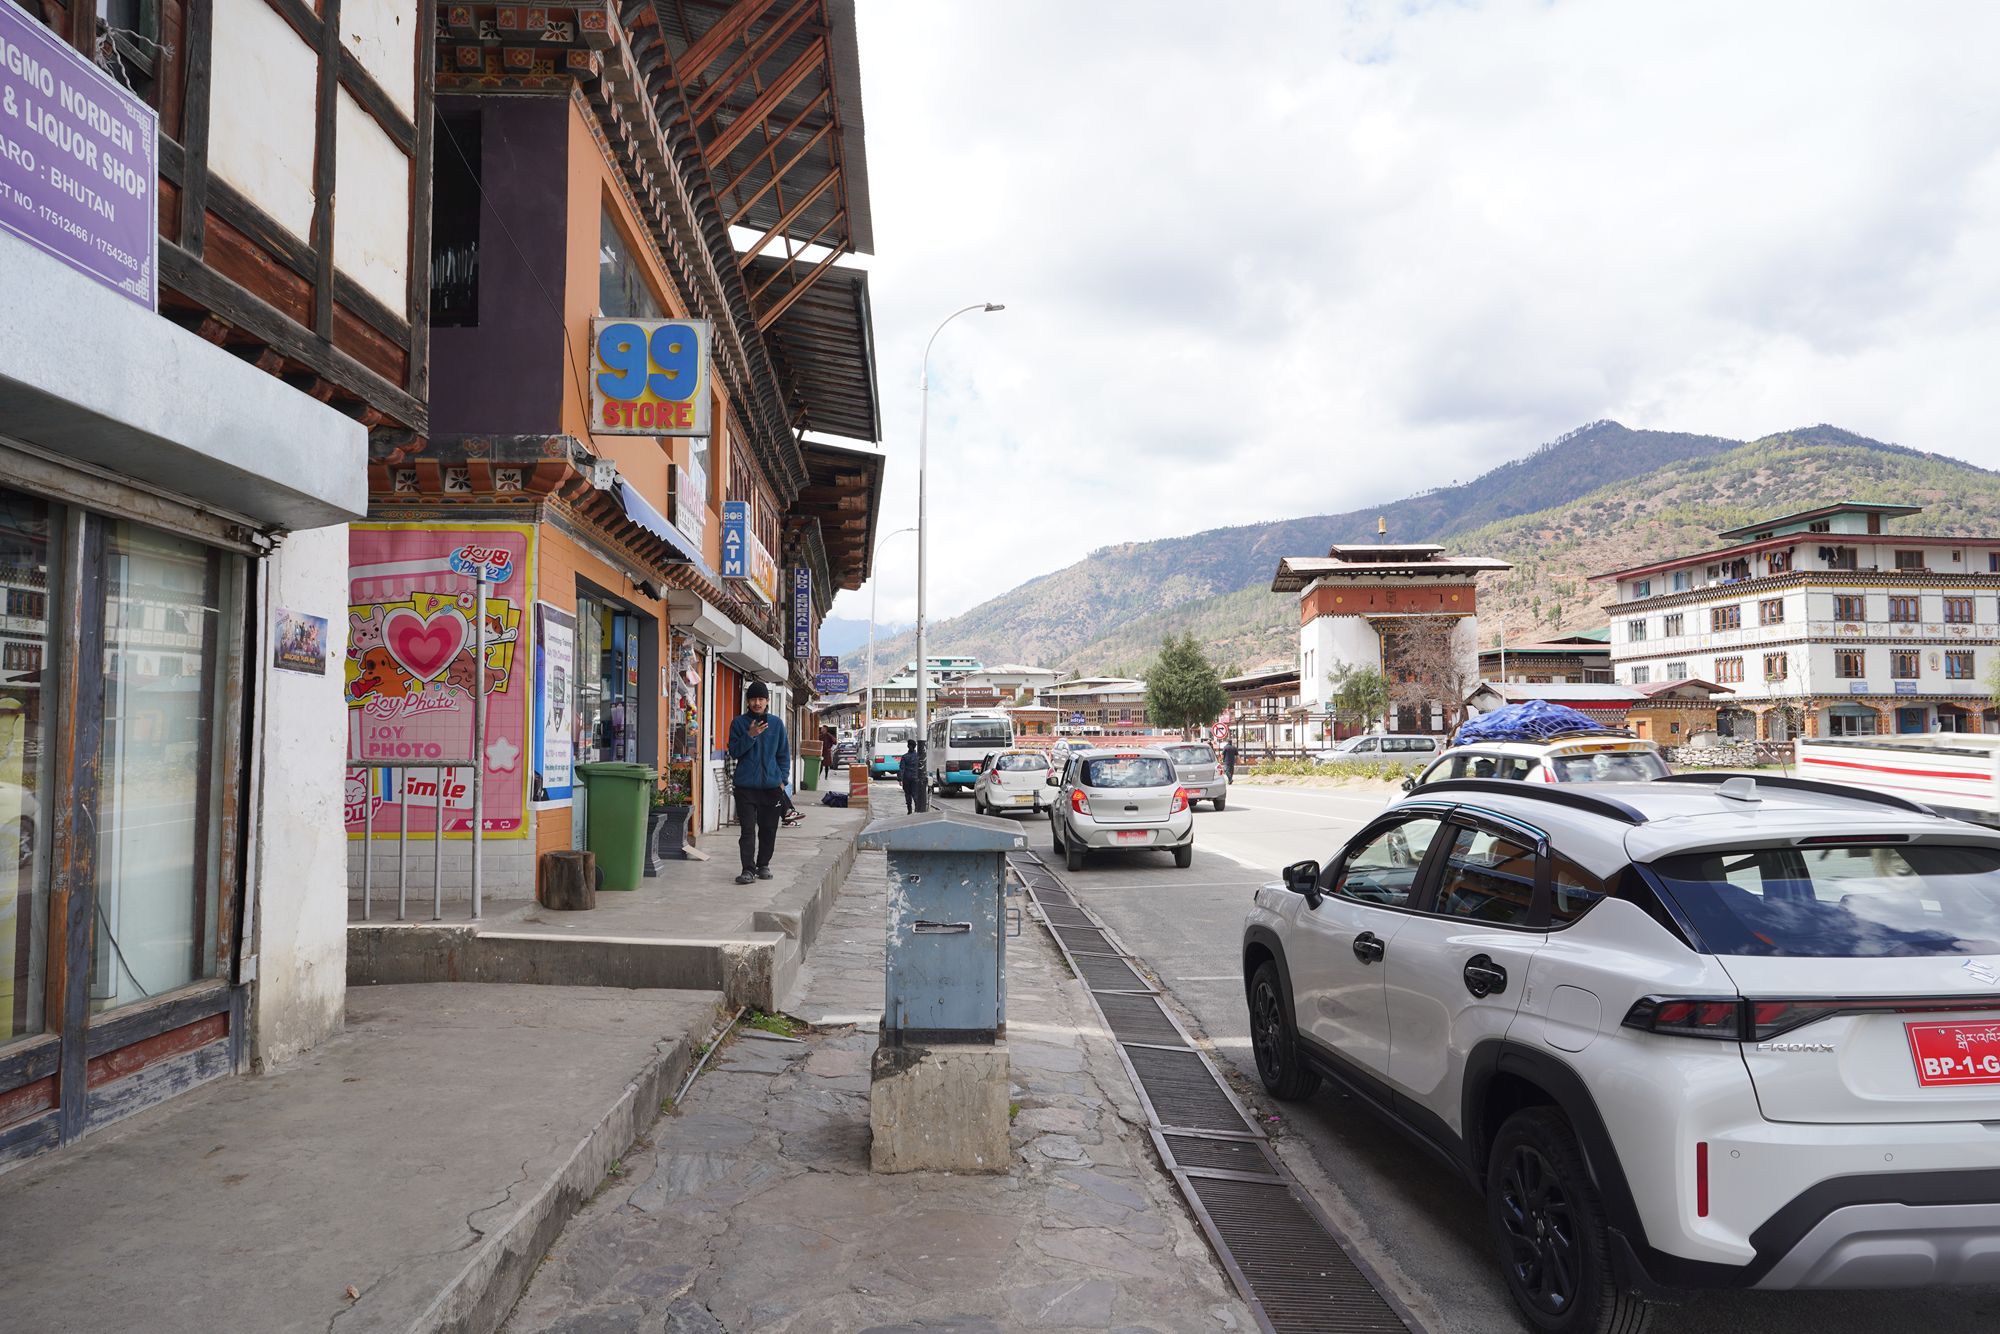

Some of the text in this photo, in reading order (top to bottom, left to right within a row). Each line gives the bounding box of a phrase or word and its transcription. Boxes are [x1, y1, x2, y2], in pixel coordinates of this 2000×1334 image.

[60, 79, 133, 155] NORDEN
[3, 84, 146, 200] & LIQUOR SHOP
[51, 166, 115, 222] BHUTAN
[14, 189, 36, 213] NO.
[39, 205, 88, 242] 17512466
[96, 238, 138, 271] 17542383
[597, 323, 698, 400] 99
[603, 402, 692, 428] STORE
[724, 511, 743, 520] BOB
[725, 529, 741, 575] ATM
[796, 593, 809, 627] GENERAL
[797, 631, 808, 656] STORE
[365, 691, 457, 719] Joy Photo
[369, 726, 405, 739] JOY
[368, 742, 442, 758] PHOTO
[398, 777, 466, 799] Smle
[1756, 1043, 1835, 1053] FRONX
